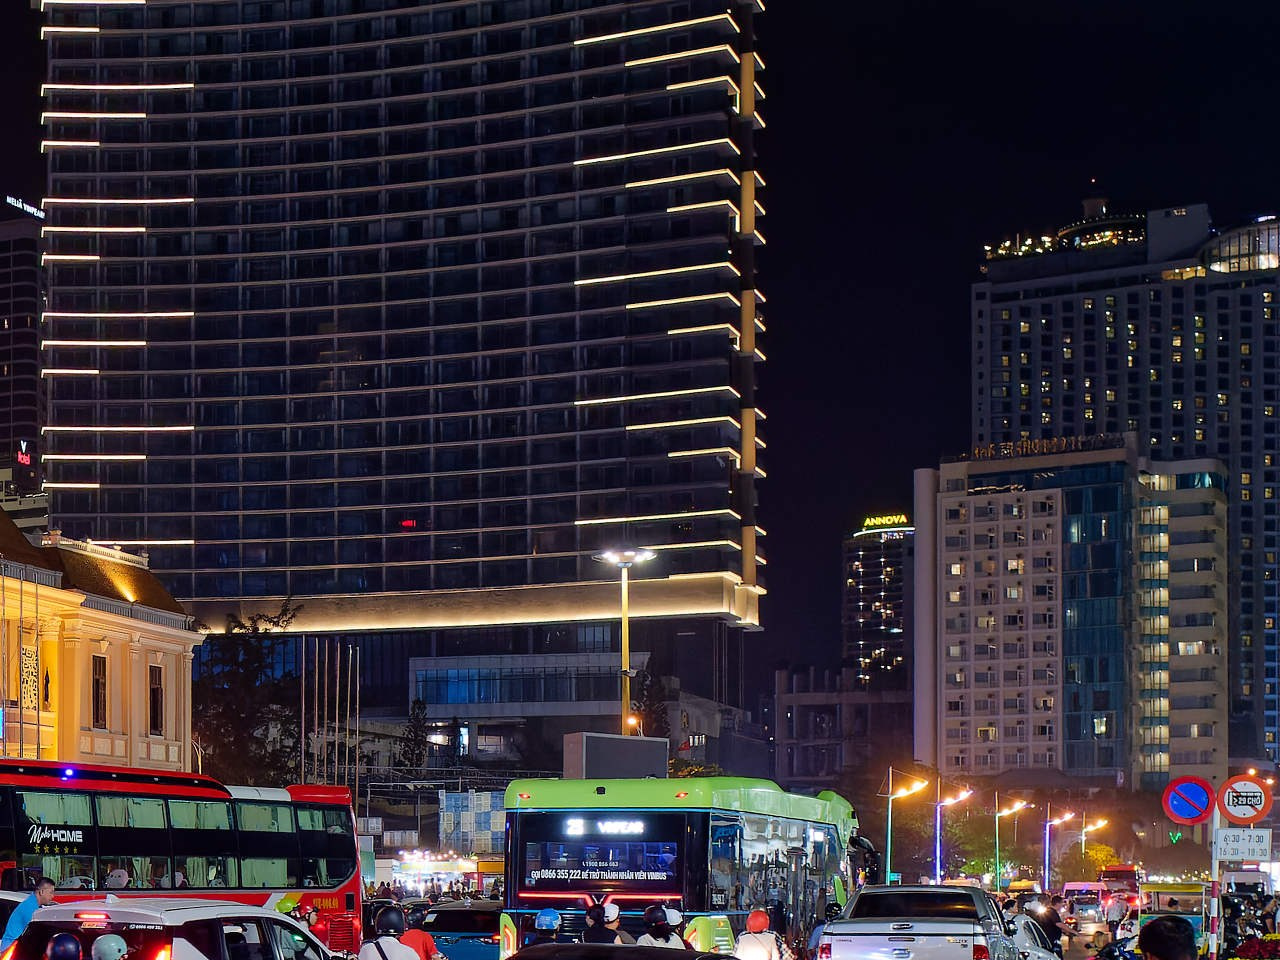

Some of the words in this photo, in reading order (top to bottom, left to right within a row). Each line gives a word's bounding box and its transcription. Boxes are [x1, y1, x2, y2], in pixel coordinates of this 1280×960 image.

[863, 514, 908, 526] ANNOVA
[51, 829, 83, 842] HOME
[541, 869, 557, 879] 0866
[557, 869, 569, 879] 355
[569, 869, 581, 879] 222
[600, 869, 618, 880] THÀNH
